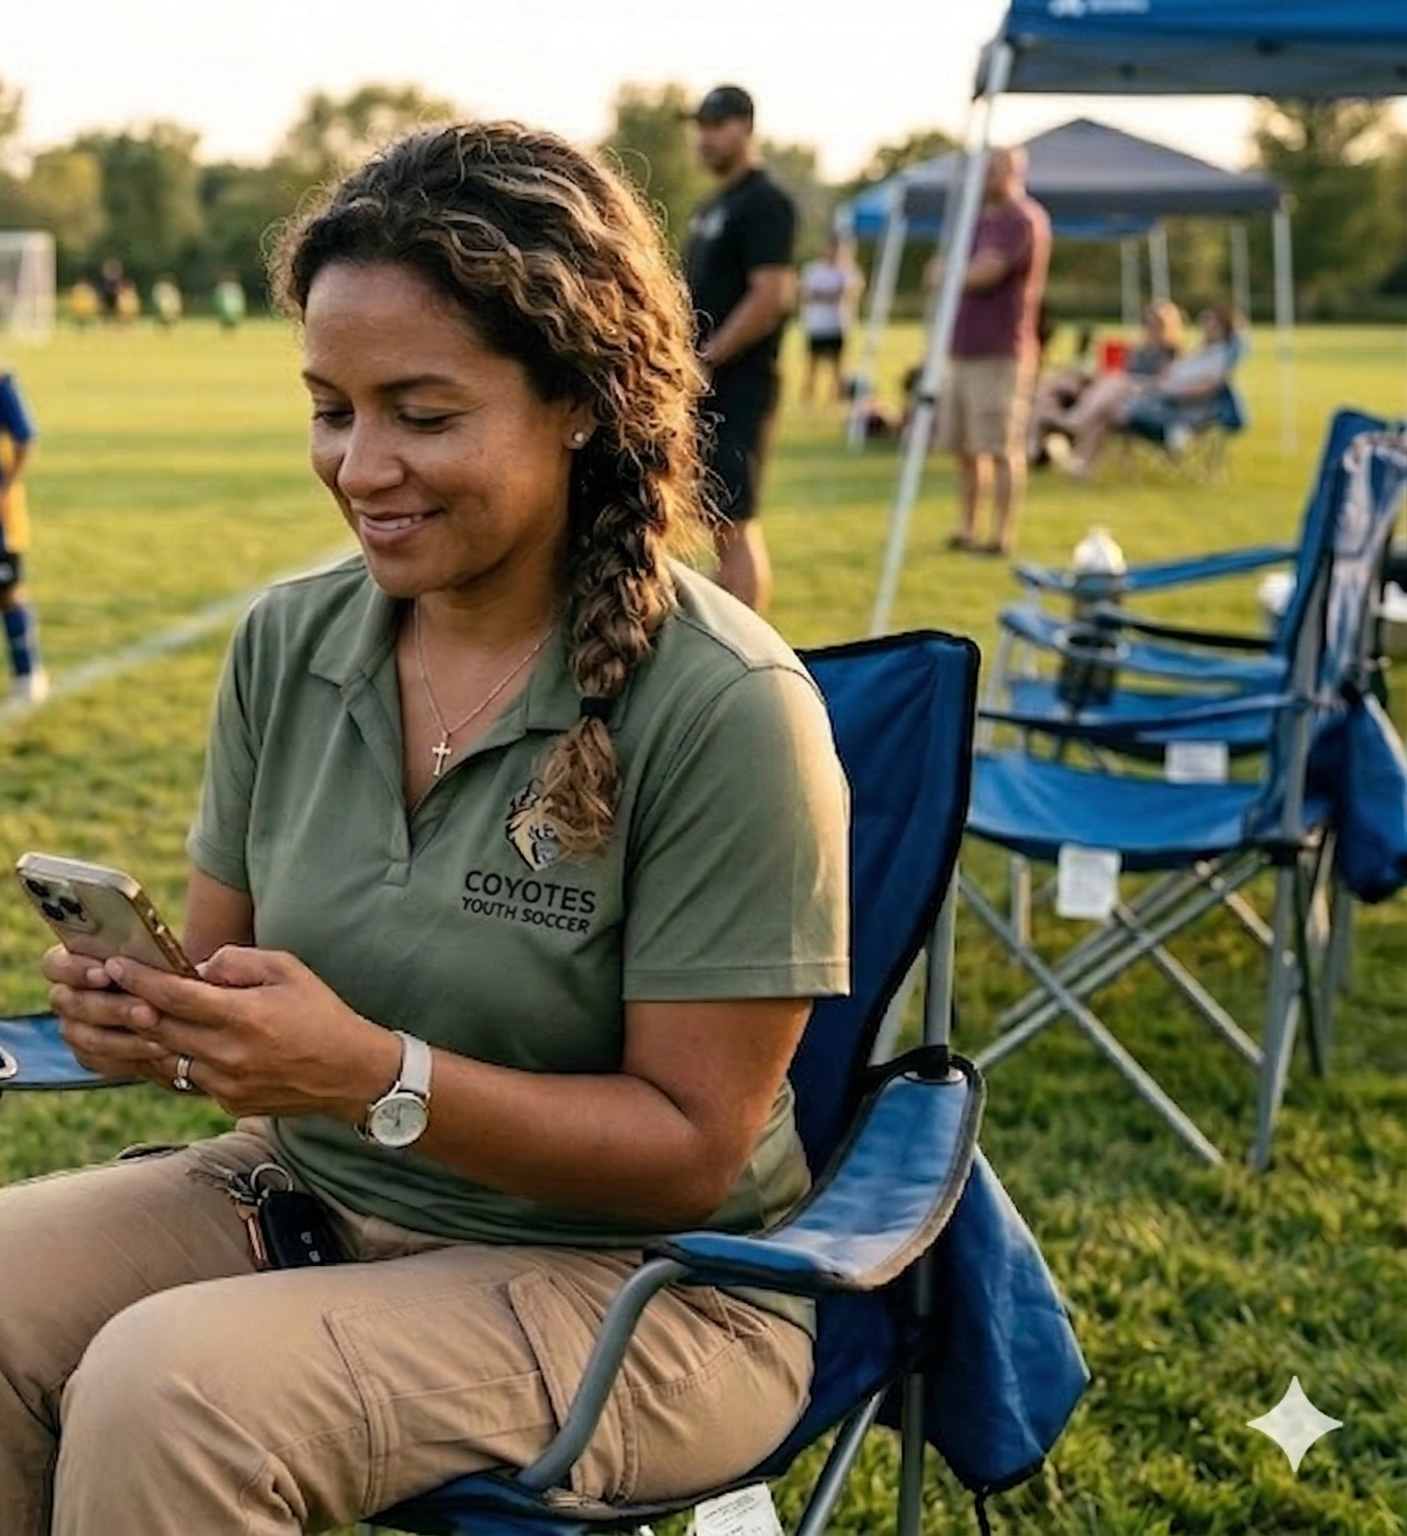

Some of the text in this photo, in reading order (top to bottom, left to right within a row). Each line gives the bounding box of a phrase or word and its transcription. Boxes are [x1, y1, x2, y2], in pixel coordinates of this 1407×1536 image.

[465, 870, 596, 914] COYOTES
[462, 896, 590, 934] YOUTH SOCCER
